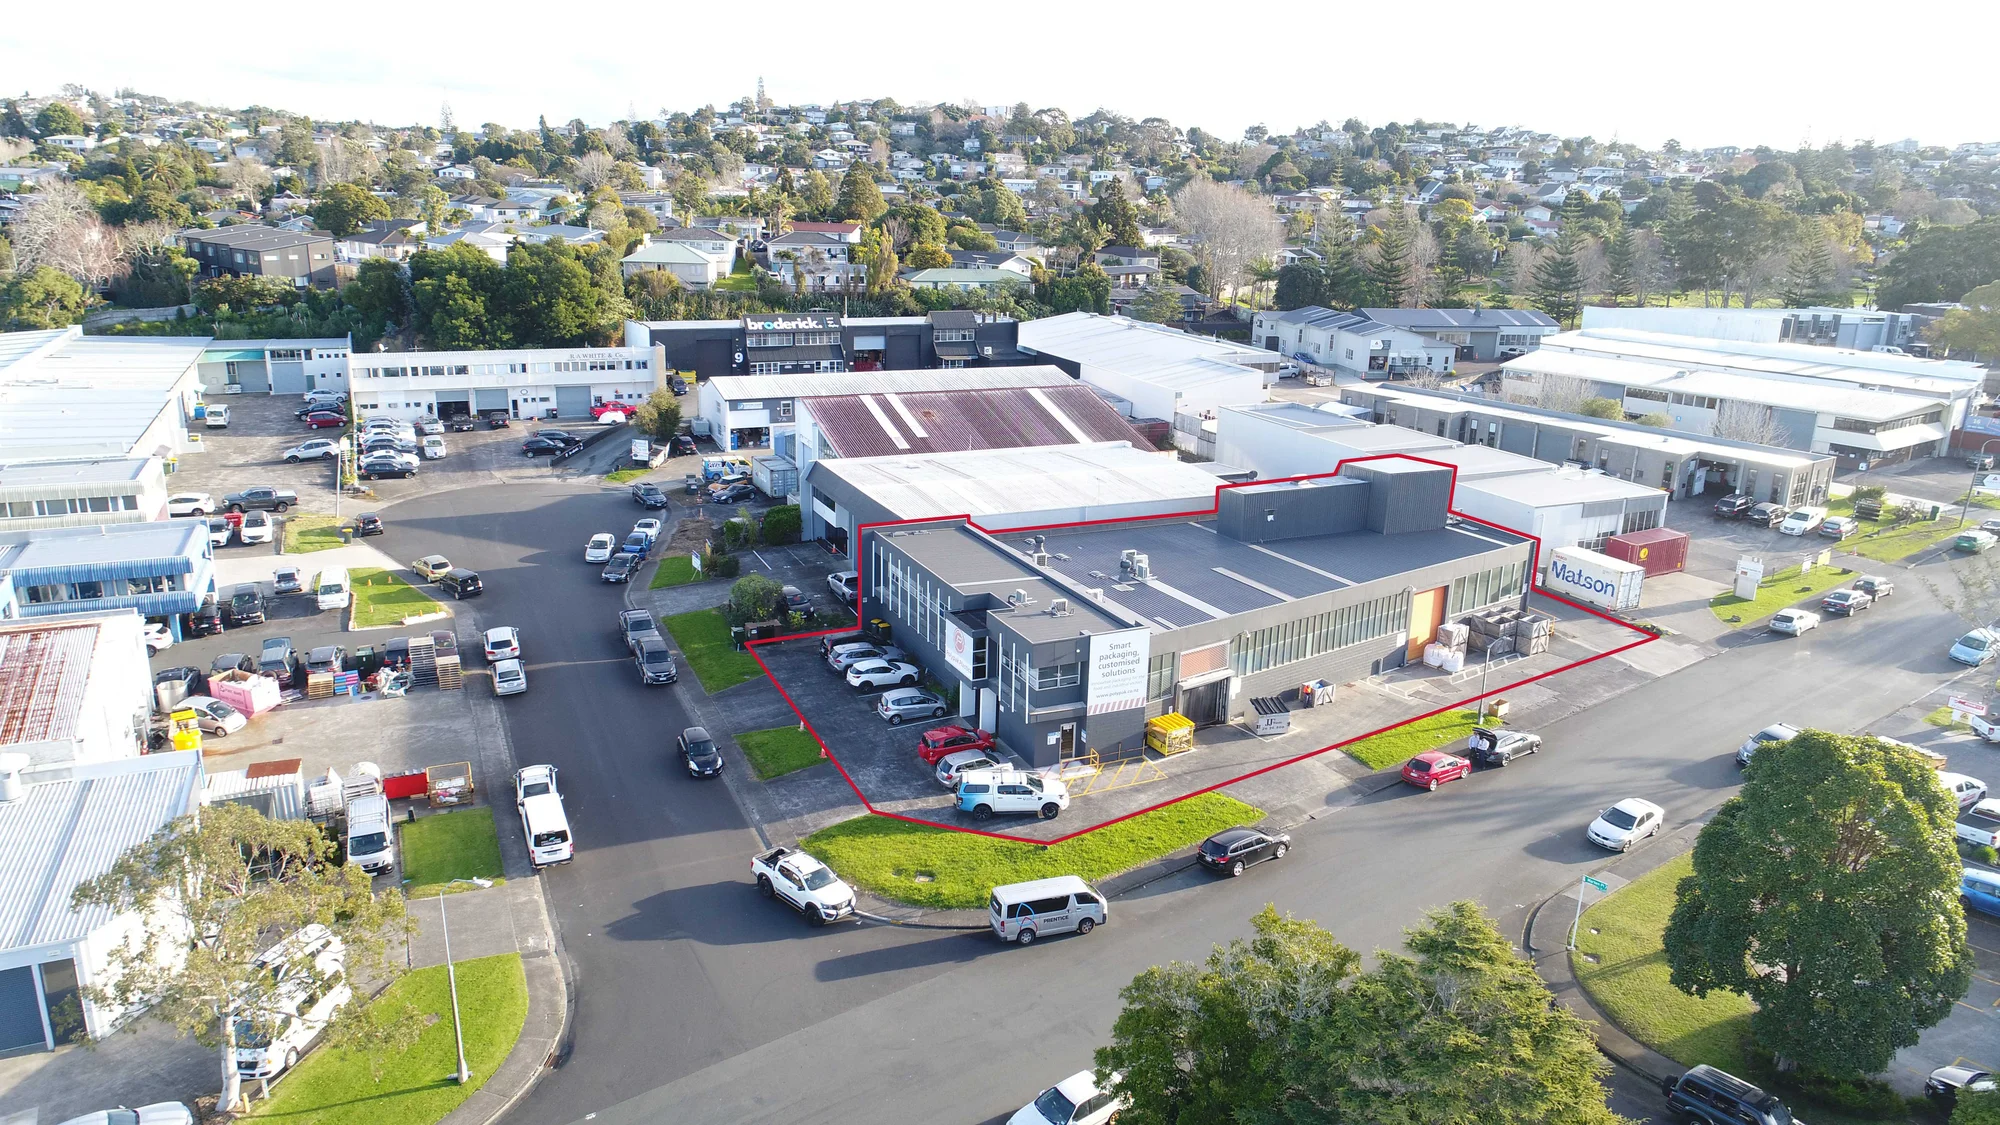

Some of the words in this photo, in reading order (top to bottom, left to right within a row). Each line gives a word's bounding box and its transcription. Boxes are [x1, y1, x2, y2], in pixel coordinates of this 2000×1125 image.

[746, 316, 823, 330] broderick.
[734, 352, 744, 363] 9
[1551, 560, 1616, 598] Matson
[1109, 641, 1131, 651] Smart
[1098, 657, 1140, 670] customised
[1101, 667, 1136, 679] solutions
[1043, 915, 1069, 924] PRENTICE
